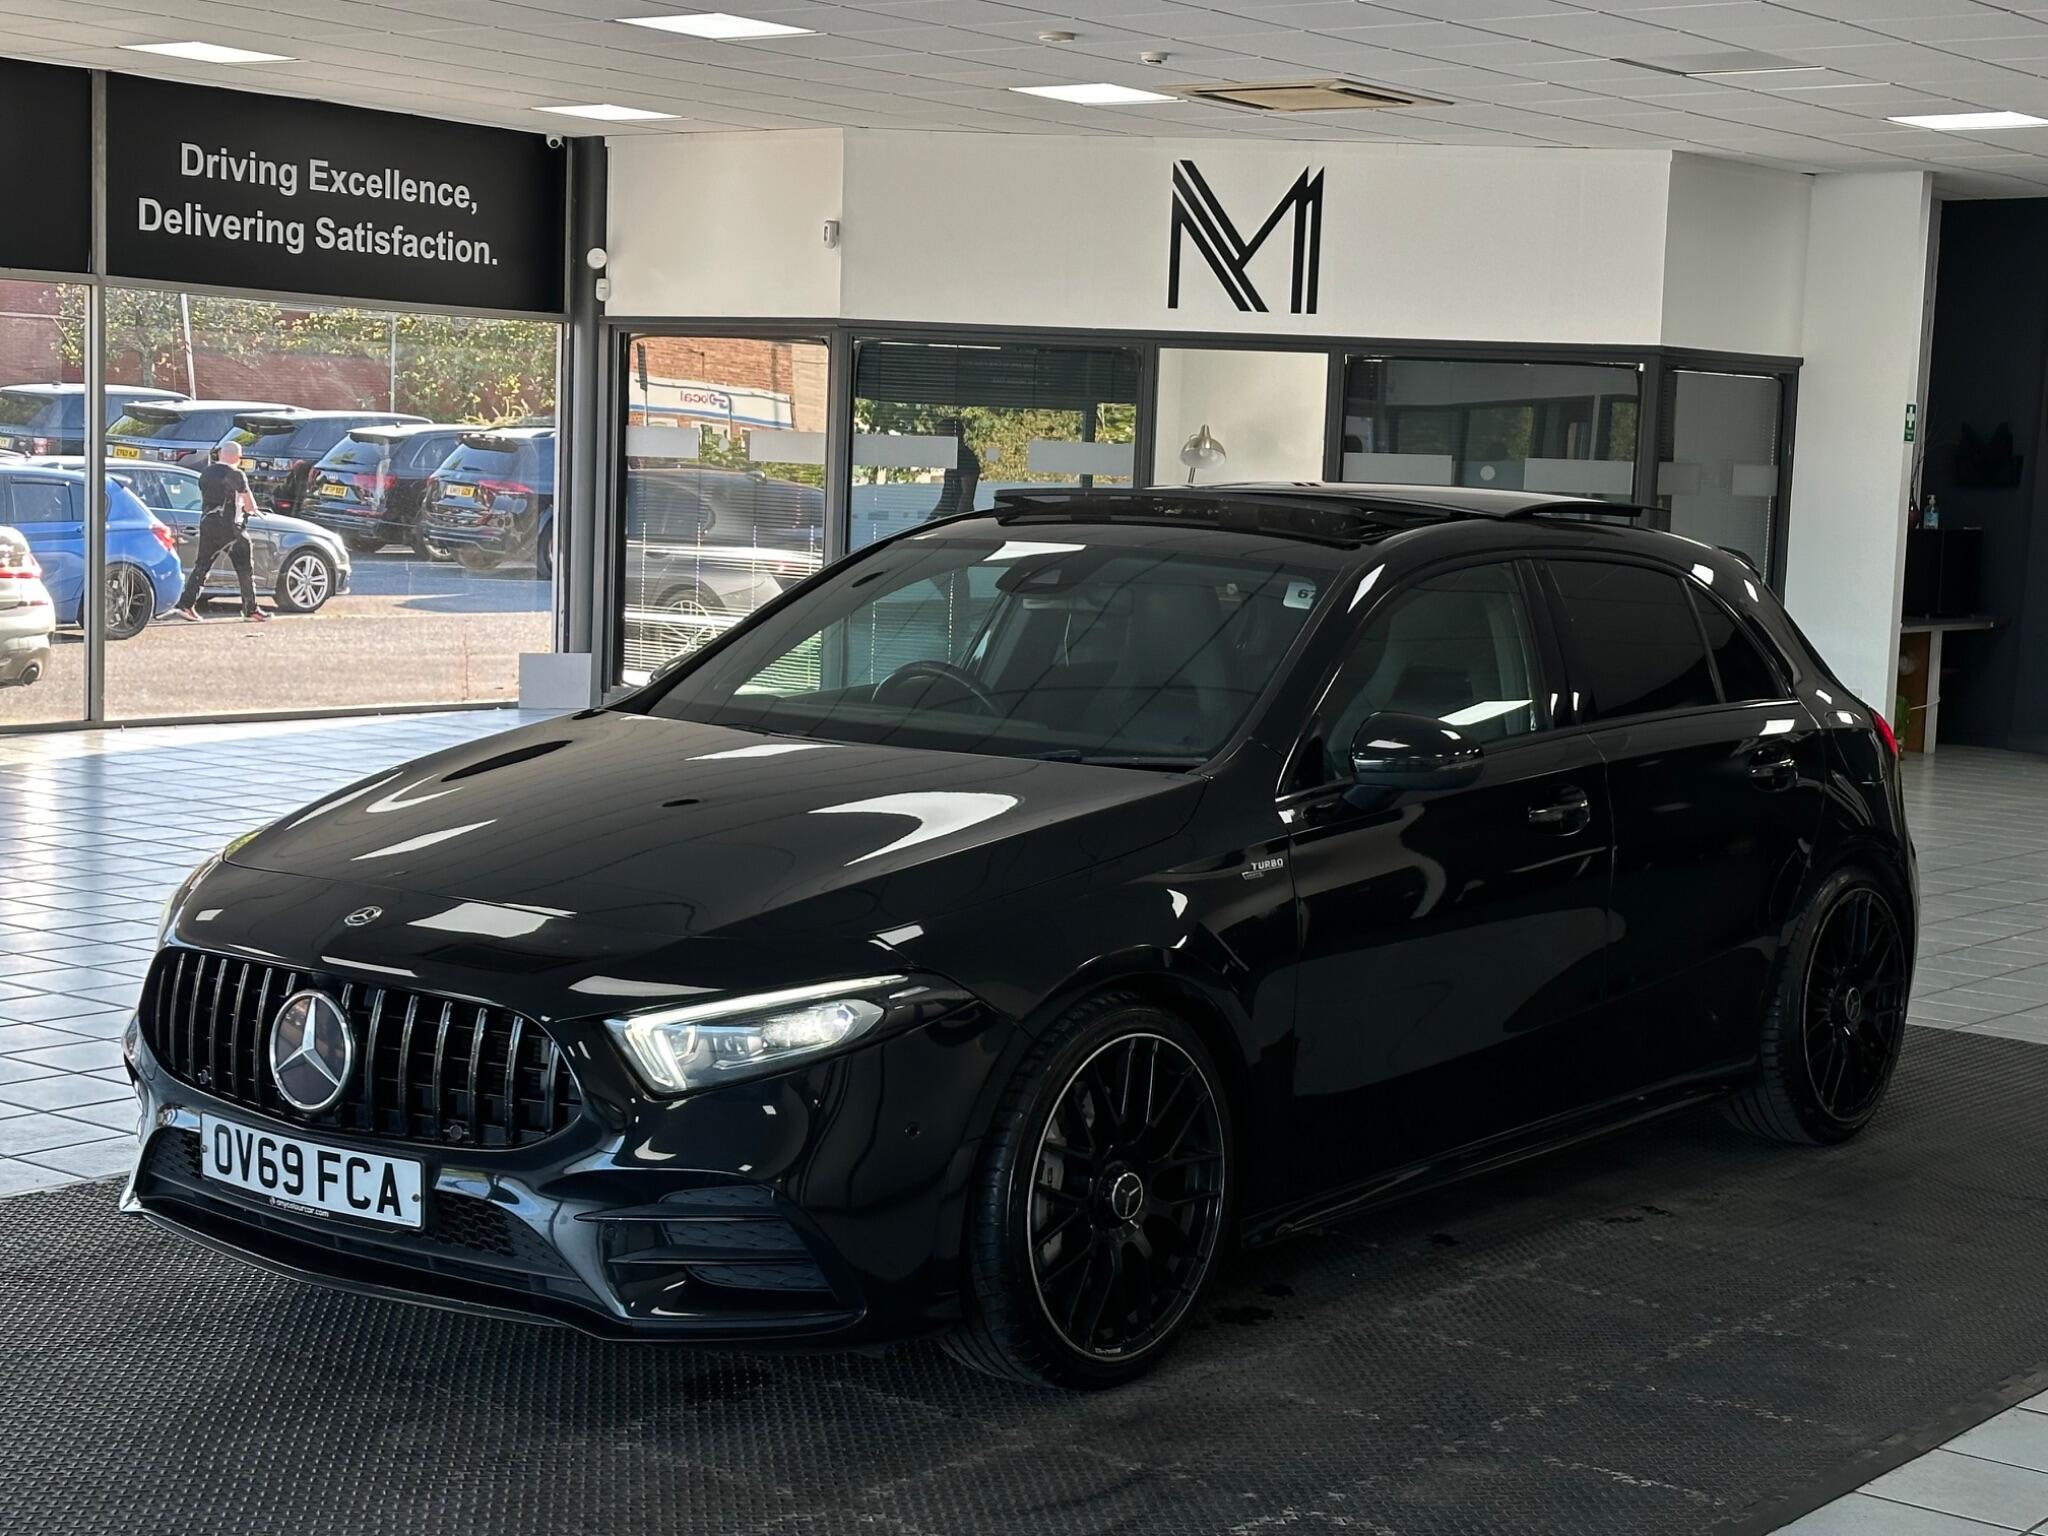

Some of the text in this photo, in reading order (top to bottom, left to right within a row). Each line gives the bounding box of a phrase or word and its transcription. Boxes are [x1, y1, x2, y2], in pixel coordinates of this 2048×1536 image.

[180, 142, 479, 215] Driving Excellence,
[137, 197, 499, 266] Delivering Satisfaction.
[1250, 857, 1284, 871] TURBO
[214, 1123, 402, 1217] OV69 FCA
